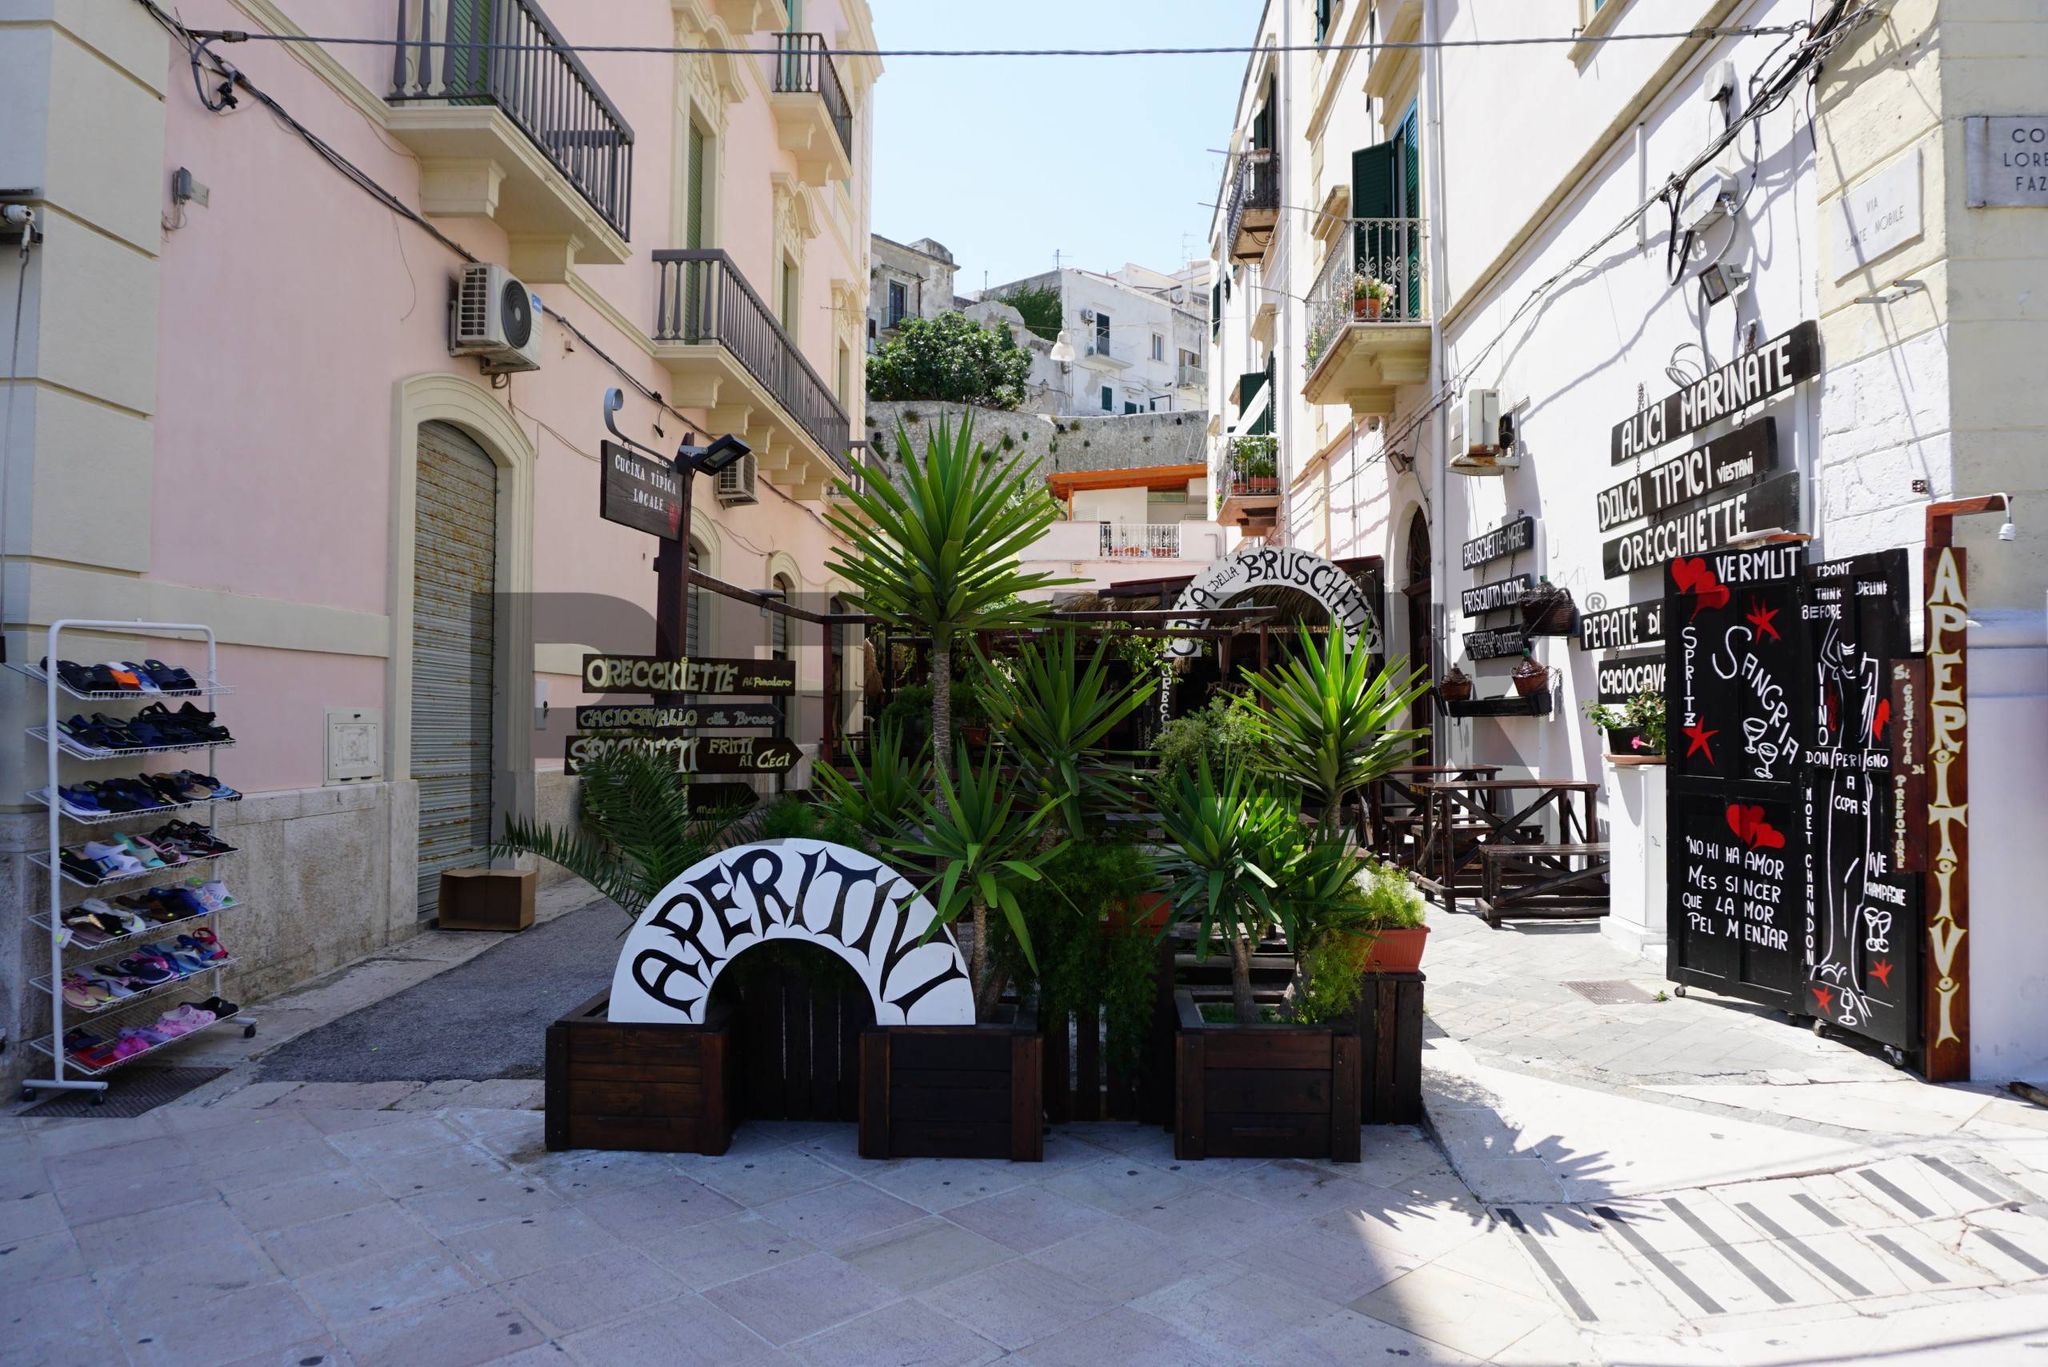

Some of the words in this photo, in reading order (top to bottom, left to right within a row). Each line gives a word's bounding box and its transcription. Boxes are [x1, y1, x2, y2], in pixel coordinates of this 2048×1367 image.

[1621, 400, 1666, 459] ALICI
[1681, 335, 1793, 431] MARINATE
[633, 488, 664, 511] LOCALE
[1598, 477, 1643, 531] DOLCI
[1651, 446, 1713, 508] TIPICI
[1619, 493, 1748, 572] ORECCHIETTE
[1207, 567, 1239, 592] DELLA
[1716, 547, 1801, 584] VERMUT
[1583, 607, 1638, 649] PEPATE
[1801, 604, 1842, 620] BEFORE
[1682, 626, 1698, 727] SPRITZ
[1712, 626, 1799, 764] SANGRIA
[1818, 662, 1829, 747] VINO
[1805, 751, 1829, 765] DON
[1847, 775, 1855, 790] A
[1688, 864, 1717, 890] MES
[1706, 842, 1719, 860] HI
[1725, 846, 1740, 865] HA
[1745, 851, 1785, 881] AMOR
[1682, 892, 1703, 909] QUE
[1804, 853, 1815, 967] CHANDON
[632, 846, 969, 1023] APERITIVI
[1687, 911, 1716, 936] PEL
